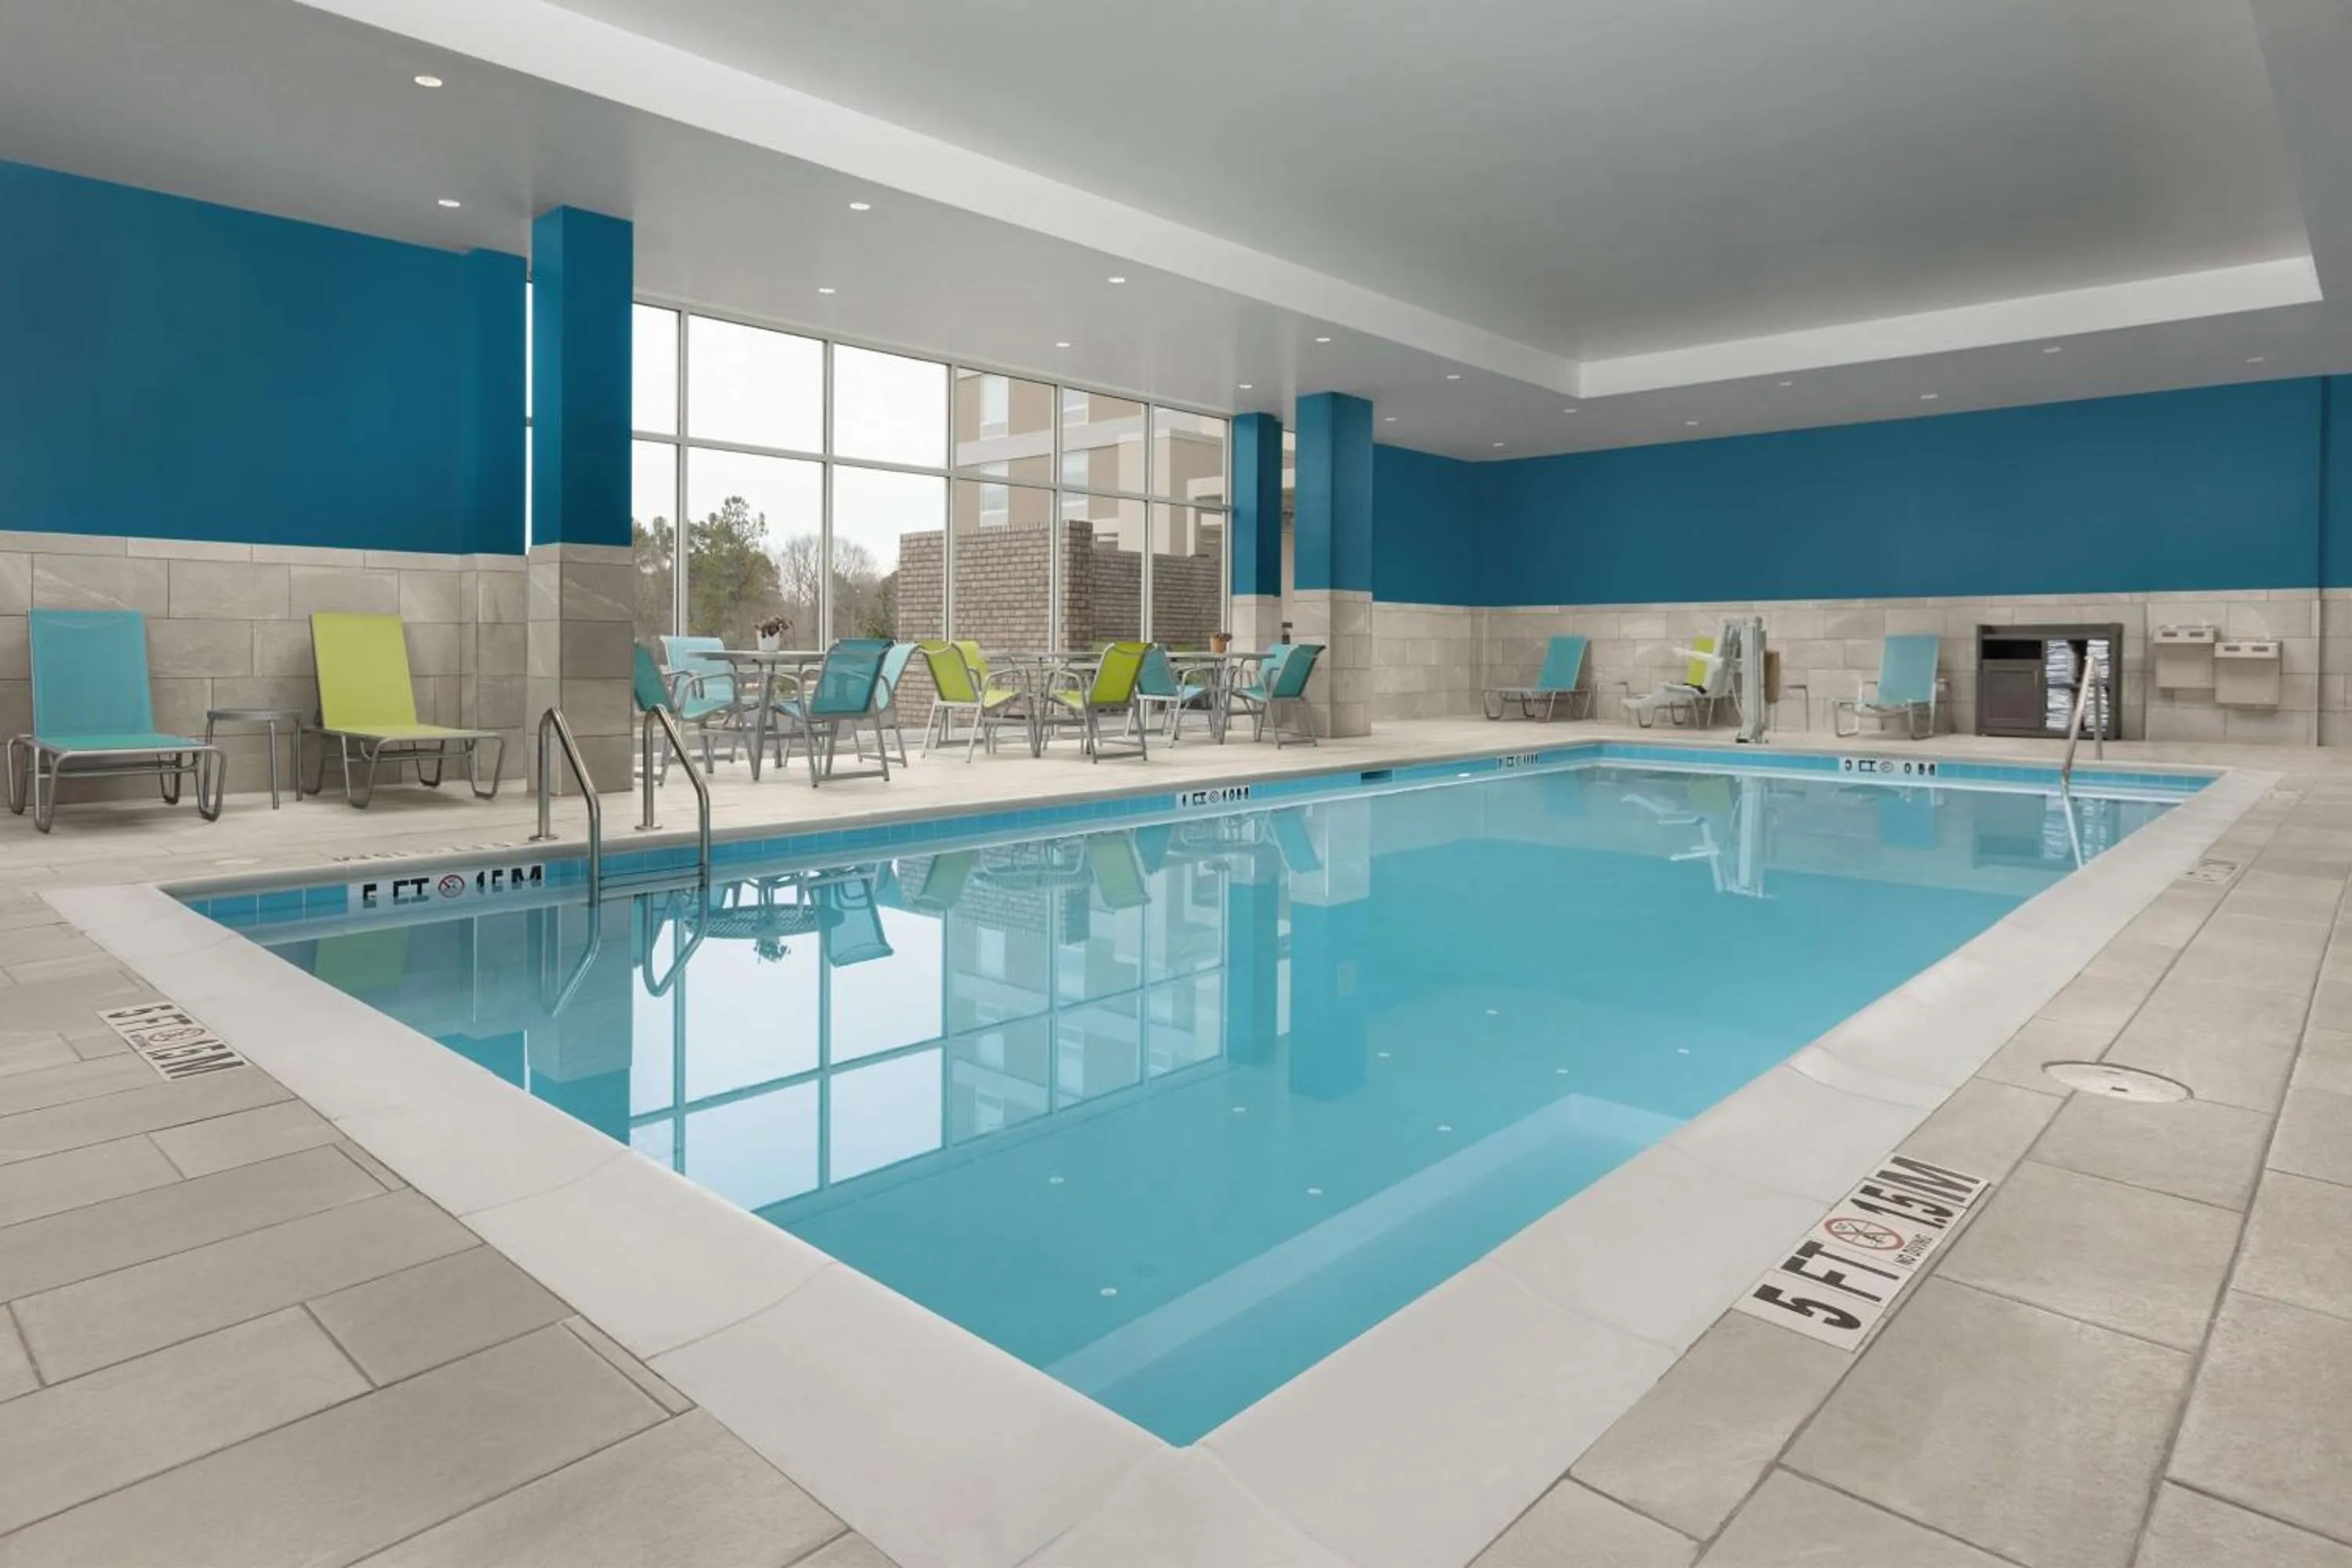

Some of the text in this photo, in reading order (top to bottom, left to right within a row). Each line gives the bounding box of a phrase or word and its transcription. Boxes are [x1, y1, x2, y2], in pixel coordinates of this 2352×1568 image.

[107, 1004, 173, 1018] 5
[116, 1014, 193, 1033] FT
[1780, 1240, 1900, 1302] FT
[1752, 1283, 1861, 1330] 5
